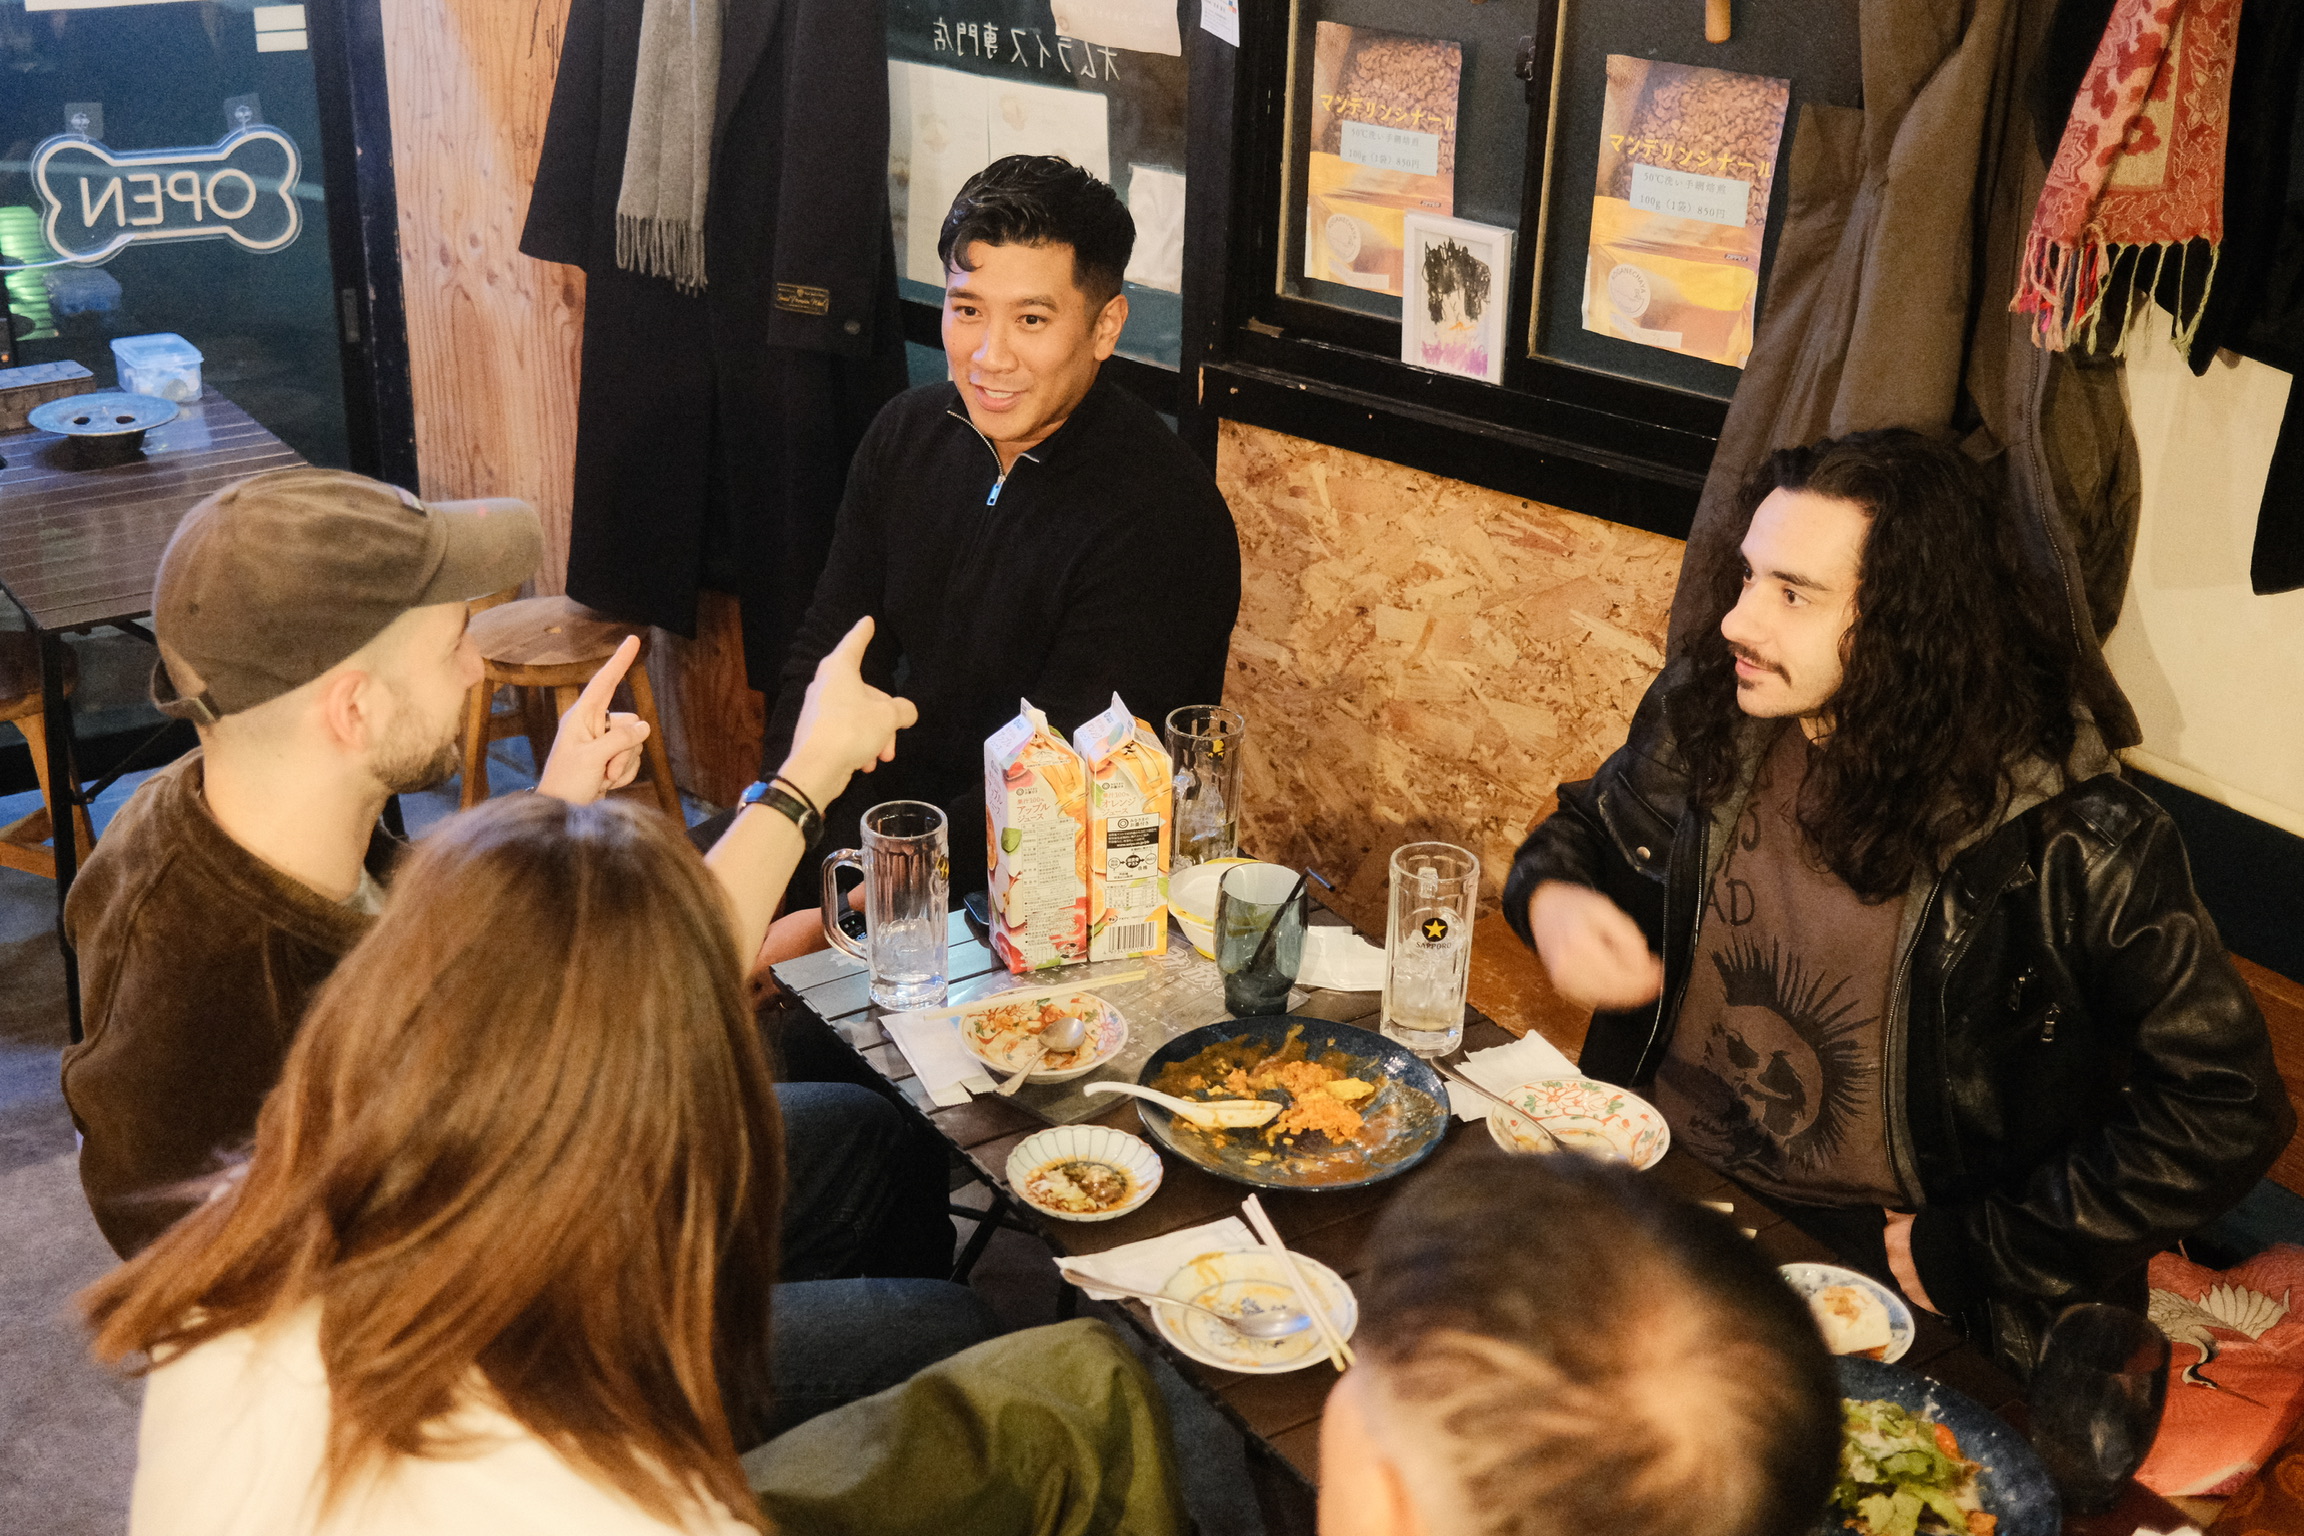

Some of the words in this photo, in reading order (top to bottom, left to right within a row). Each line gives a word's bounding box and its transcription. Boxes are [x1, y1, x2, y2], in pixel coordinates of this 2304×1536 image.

[1320, 94, 1455, 131] マンデリンシナール
[1609, 134, 1771, 178] マンデリンシナール
[1102, 797, 1136, 808] オレンジ
[1017, 802, 1050, 816] アップル
[1102, 808, 1129, 817] ジュース
[1017, 813, 1045, 824] ジュース
[1702, 878, 1755, 927] AD
[1416, 942, 1452, 950] SAPPORO
